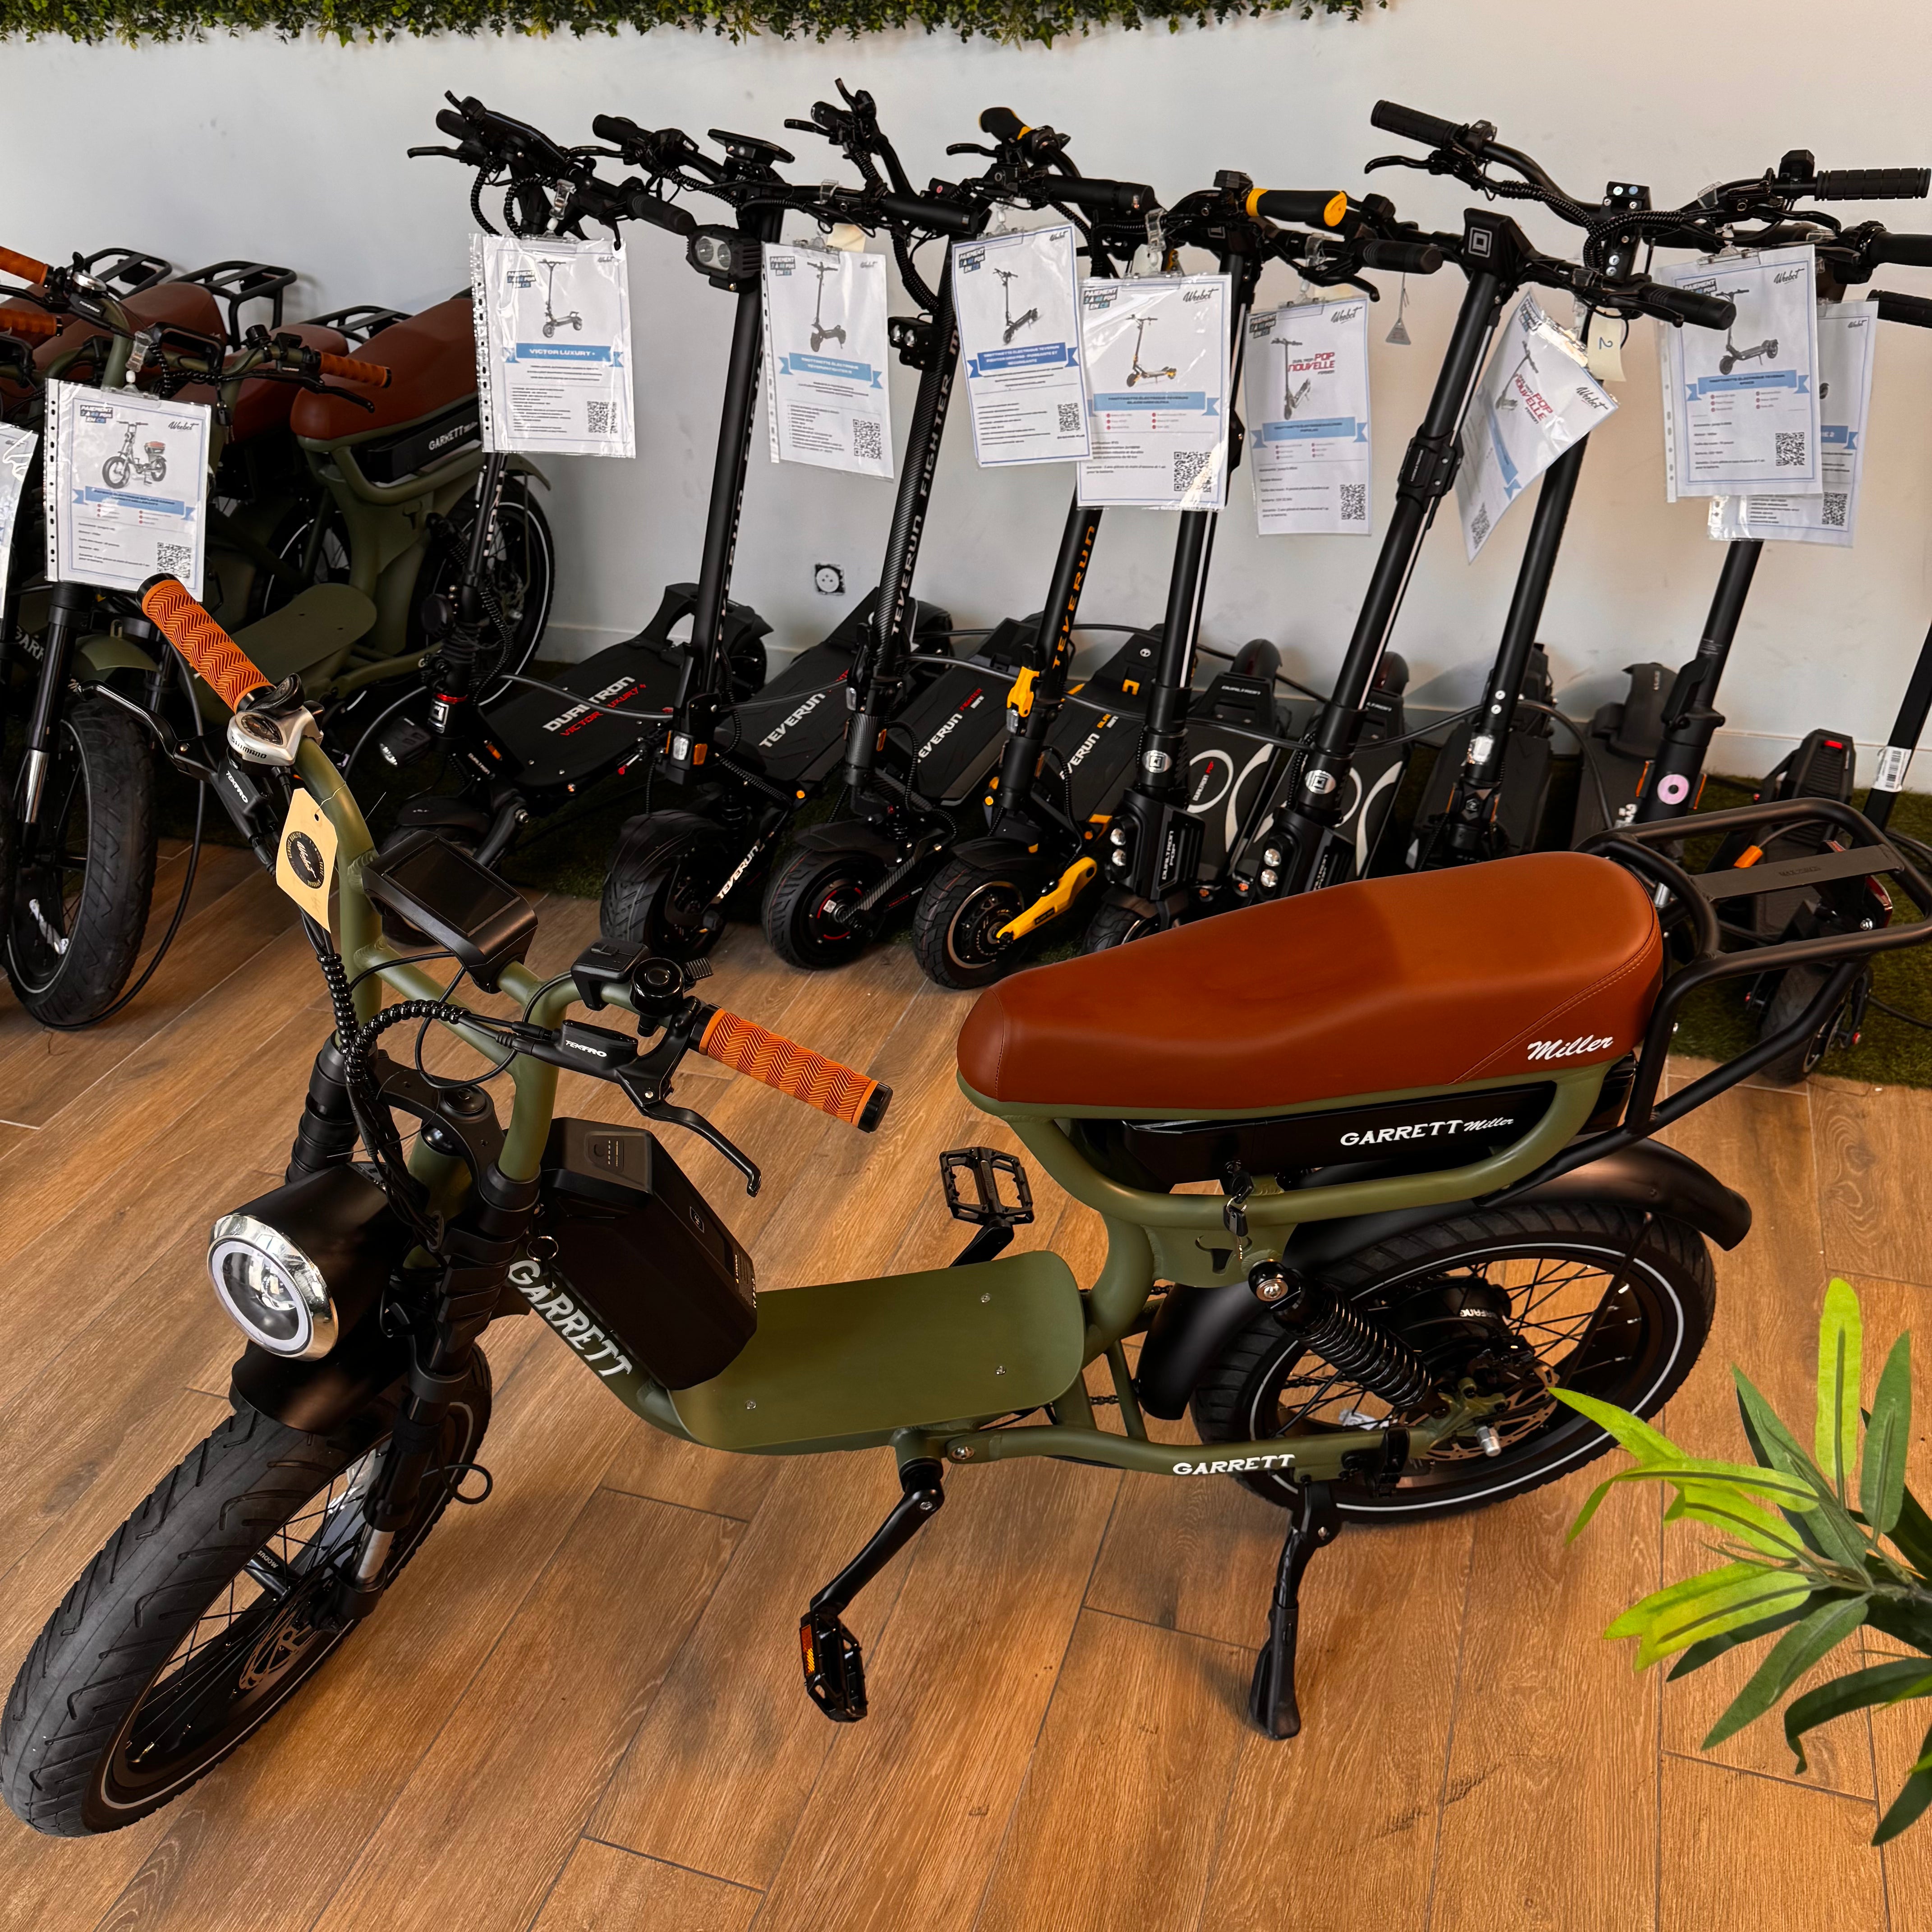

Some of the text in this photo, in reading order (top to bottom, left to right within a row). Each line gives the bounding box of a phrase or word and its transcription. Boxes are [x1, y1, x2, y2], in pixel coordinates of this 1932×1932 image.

[1182, 289, 1219, 303] Weebot
[1288, 360, 1335, 372] NOUVELLE
[1315, 352, 1335, 361] POP
[1532, 393, 1553, 413] POP
[168, 421, 199, 431] Weebot
[920, 374, 952, 497] FIGHTER
[891, 514, 922, 635] TEVERUN
[1052, 526, 1095, 670] TEVERUN
[560, 711, 603, 736] VICTOR
[606, 687, 639, 708] UXURY
[759, 693, 826, 747] TEVERUN
[917, 713, 963, 763] EVERUN
[717, 845, 759, 899] TEVERUN
[566, 1040, 607, 1057] TEKTRO
[1527, 1034, 1614, 1061] Miller
[1340, 1117, 1514, 1146] GARRETT Miller
[509, 1260, 632, 1377] GARRETT
[1173, 1454, 1295, 1475] GARRETT
